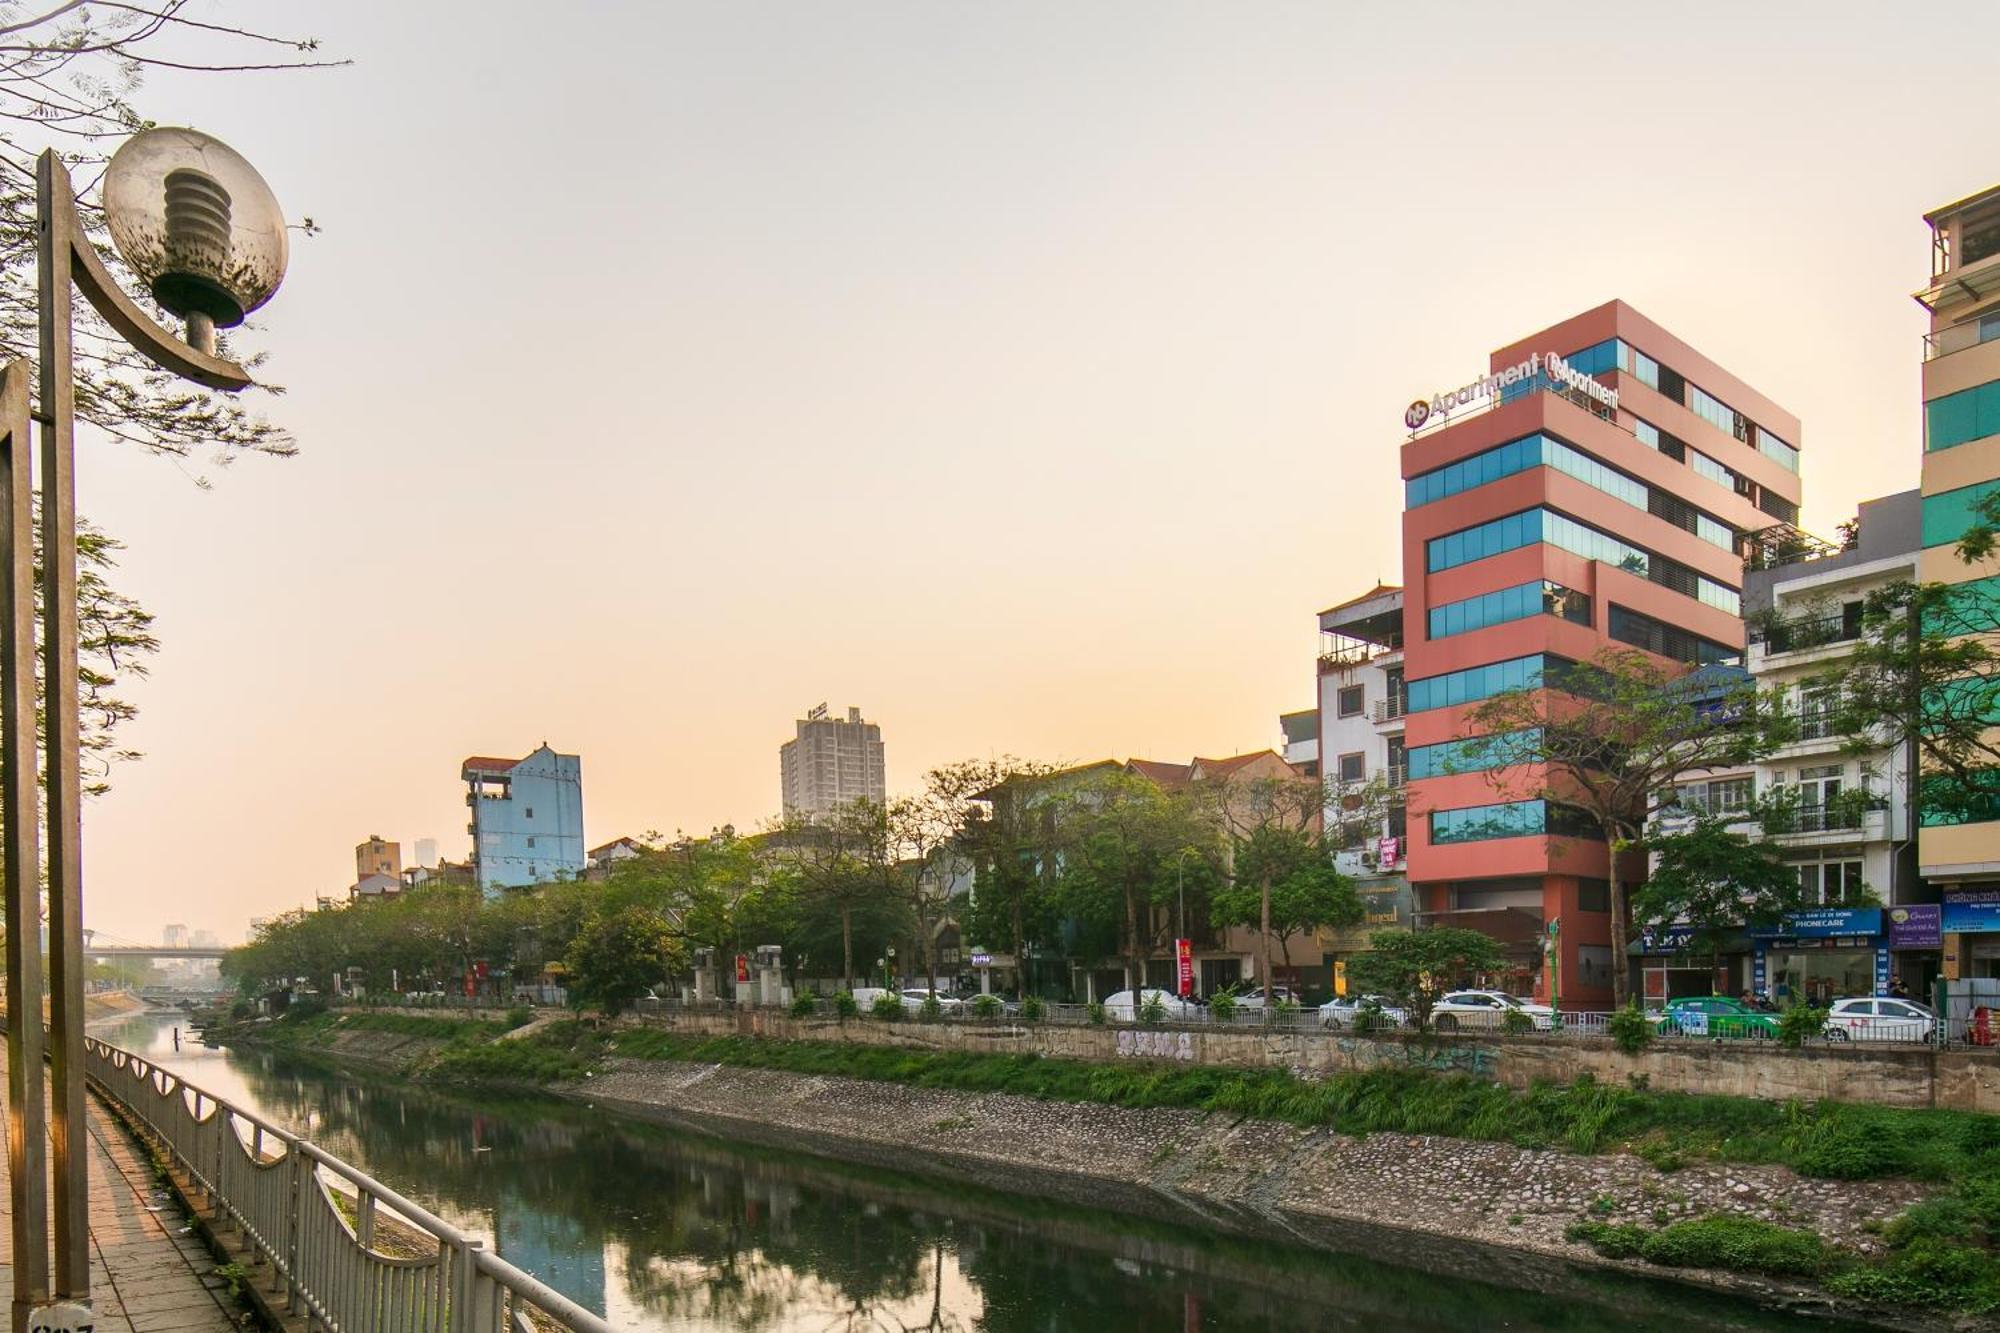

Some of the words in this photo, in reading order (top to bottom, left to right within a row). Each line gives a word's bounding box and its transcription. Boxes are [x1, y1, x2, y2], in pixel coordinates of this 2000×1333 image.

[1431, 352, 1539, 417] Apartment
[1563, 359, 1619, 411] Apartment
[1795, 919, 1845, 928] PHONECARE
